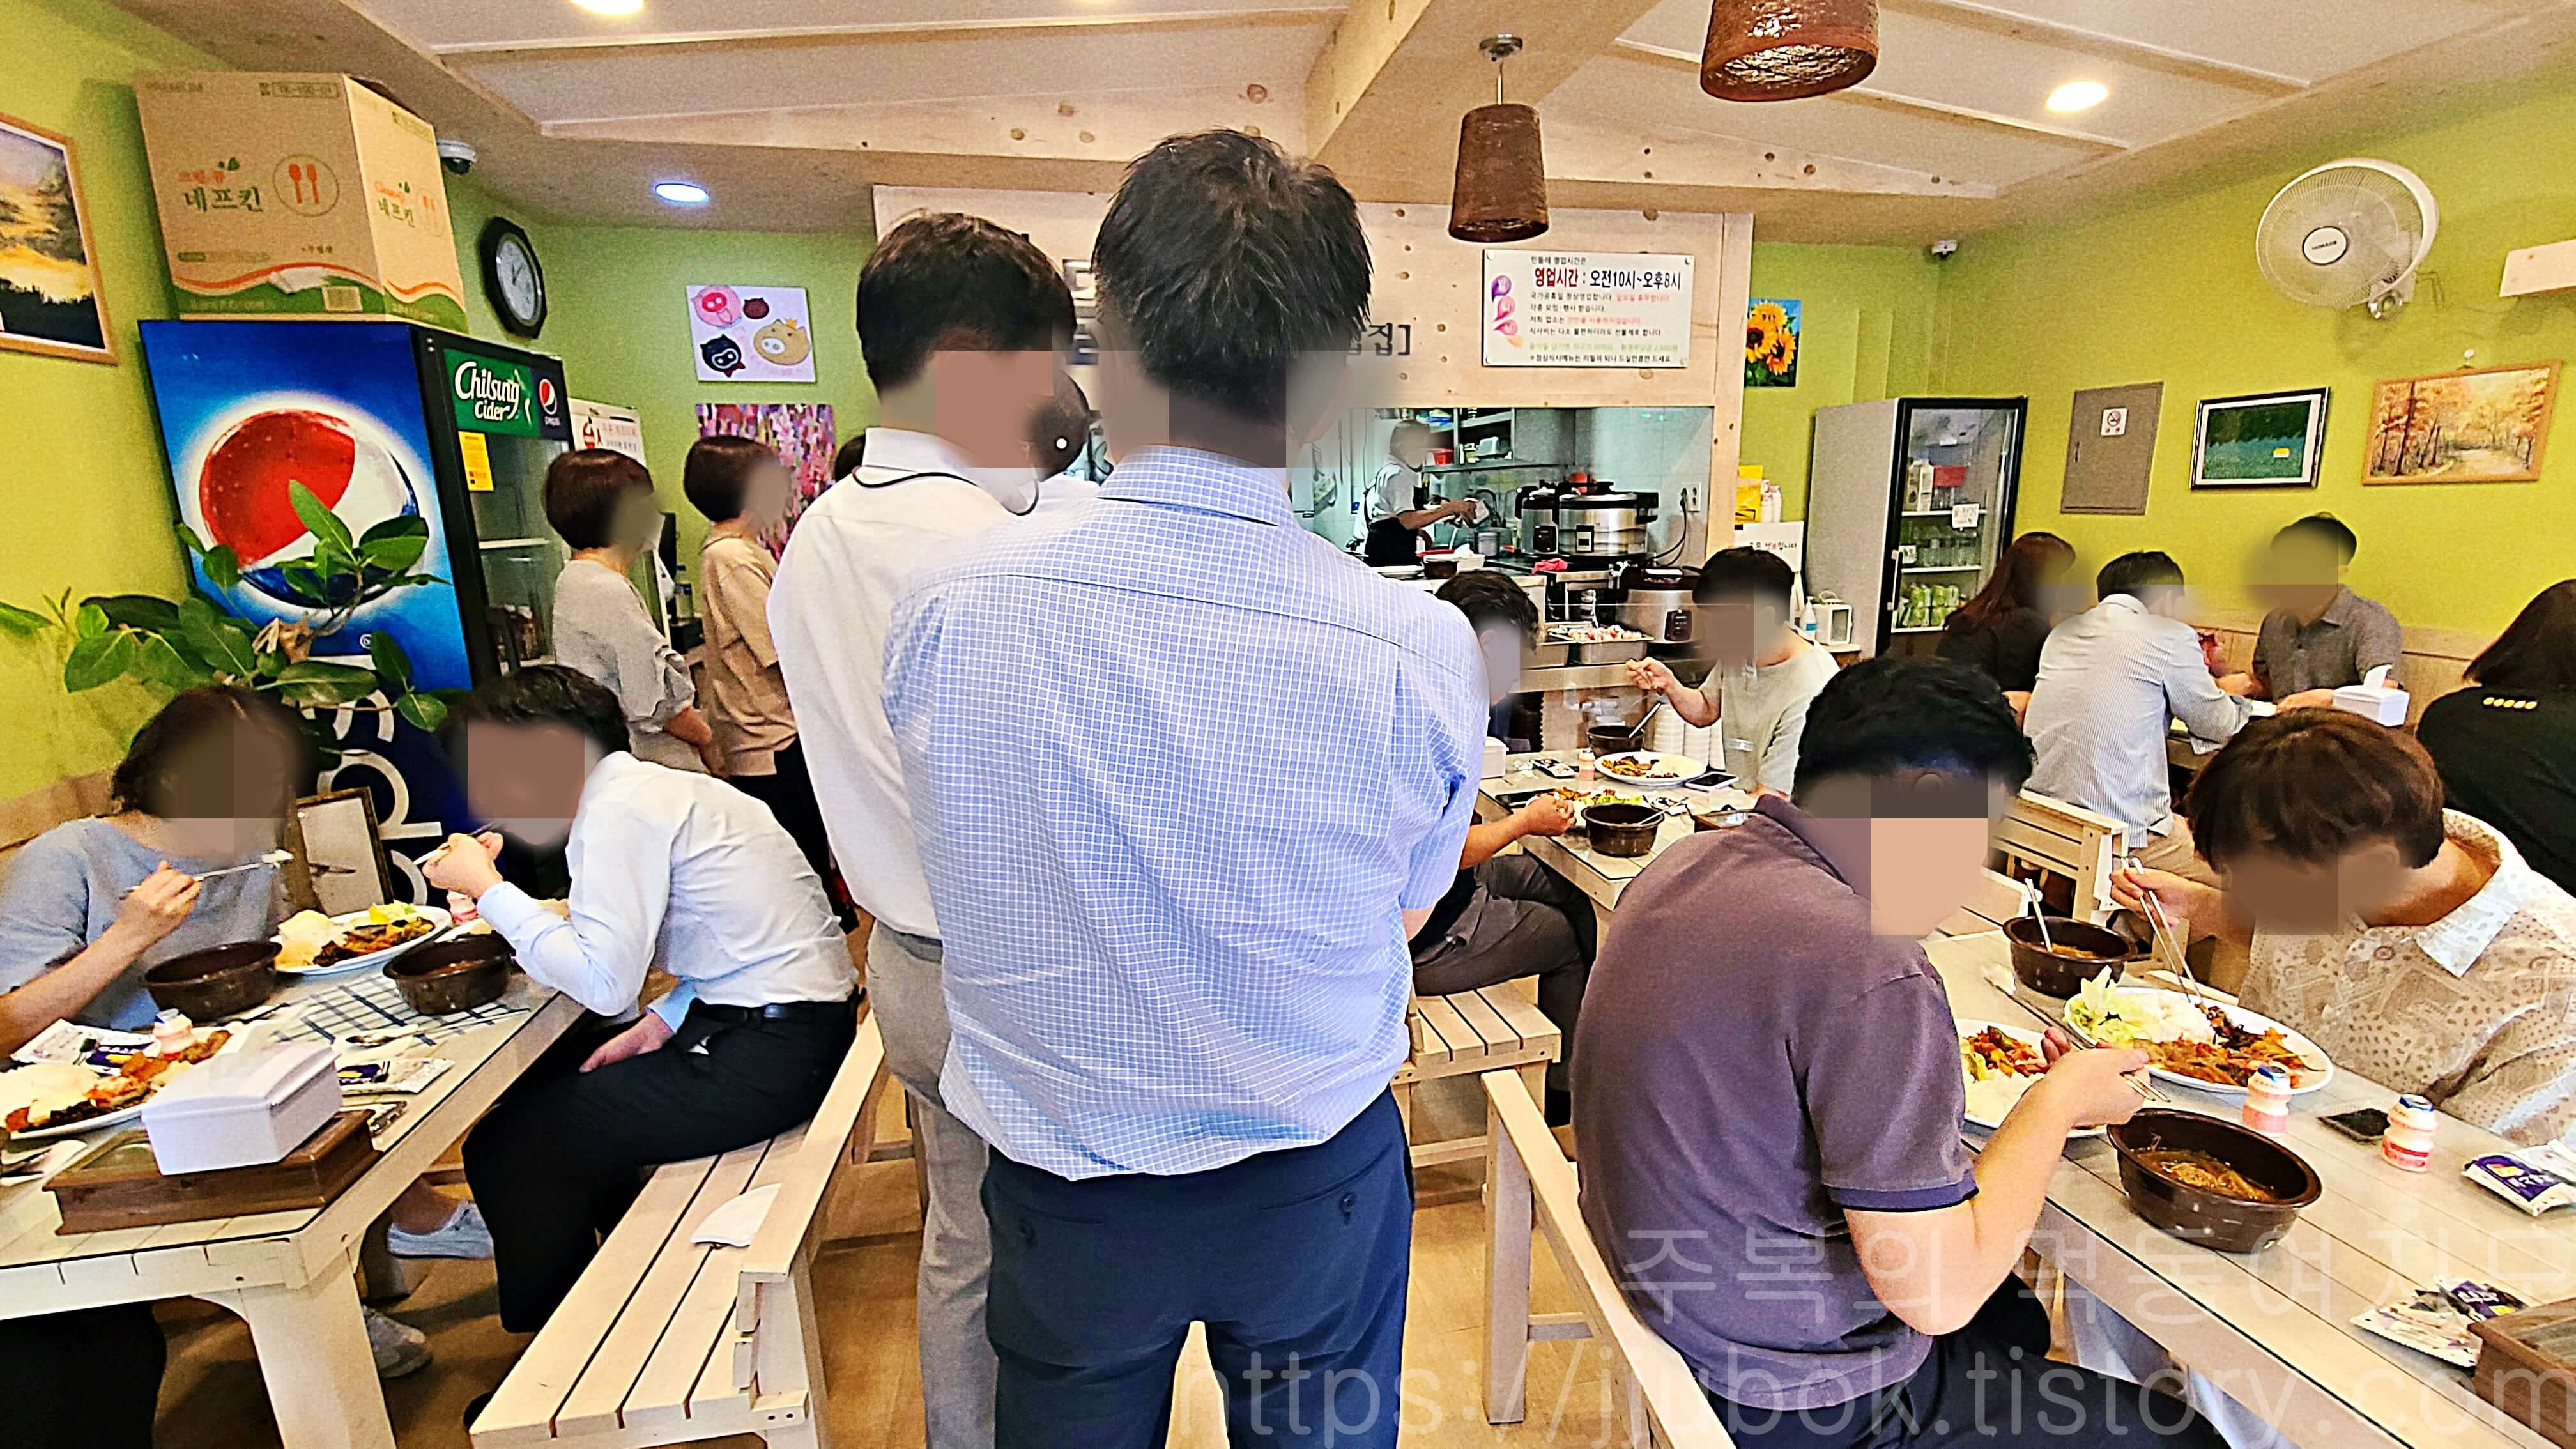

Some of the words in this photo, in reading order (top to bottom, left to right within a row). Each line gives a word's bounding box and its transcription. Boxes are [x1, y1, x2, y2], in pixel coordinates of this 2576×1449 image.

[184, 185, 263, 212] 네프킨
[1535, 267, 1579, 288] 영업시간
[1590, 270, 1681, 290] 오전10시~오후8시
[454, 361, 519, 419] Chilsung
[475, 399, 510, 421] Cider
